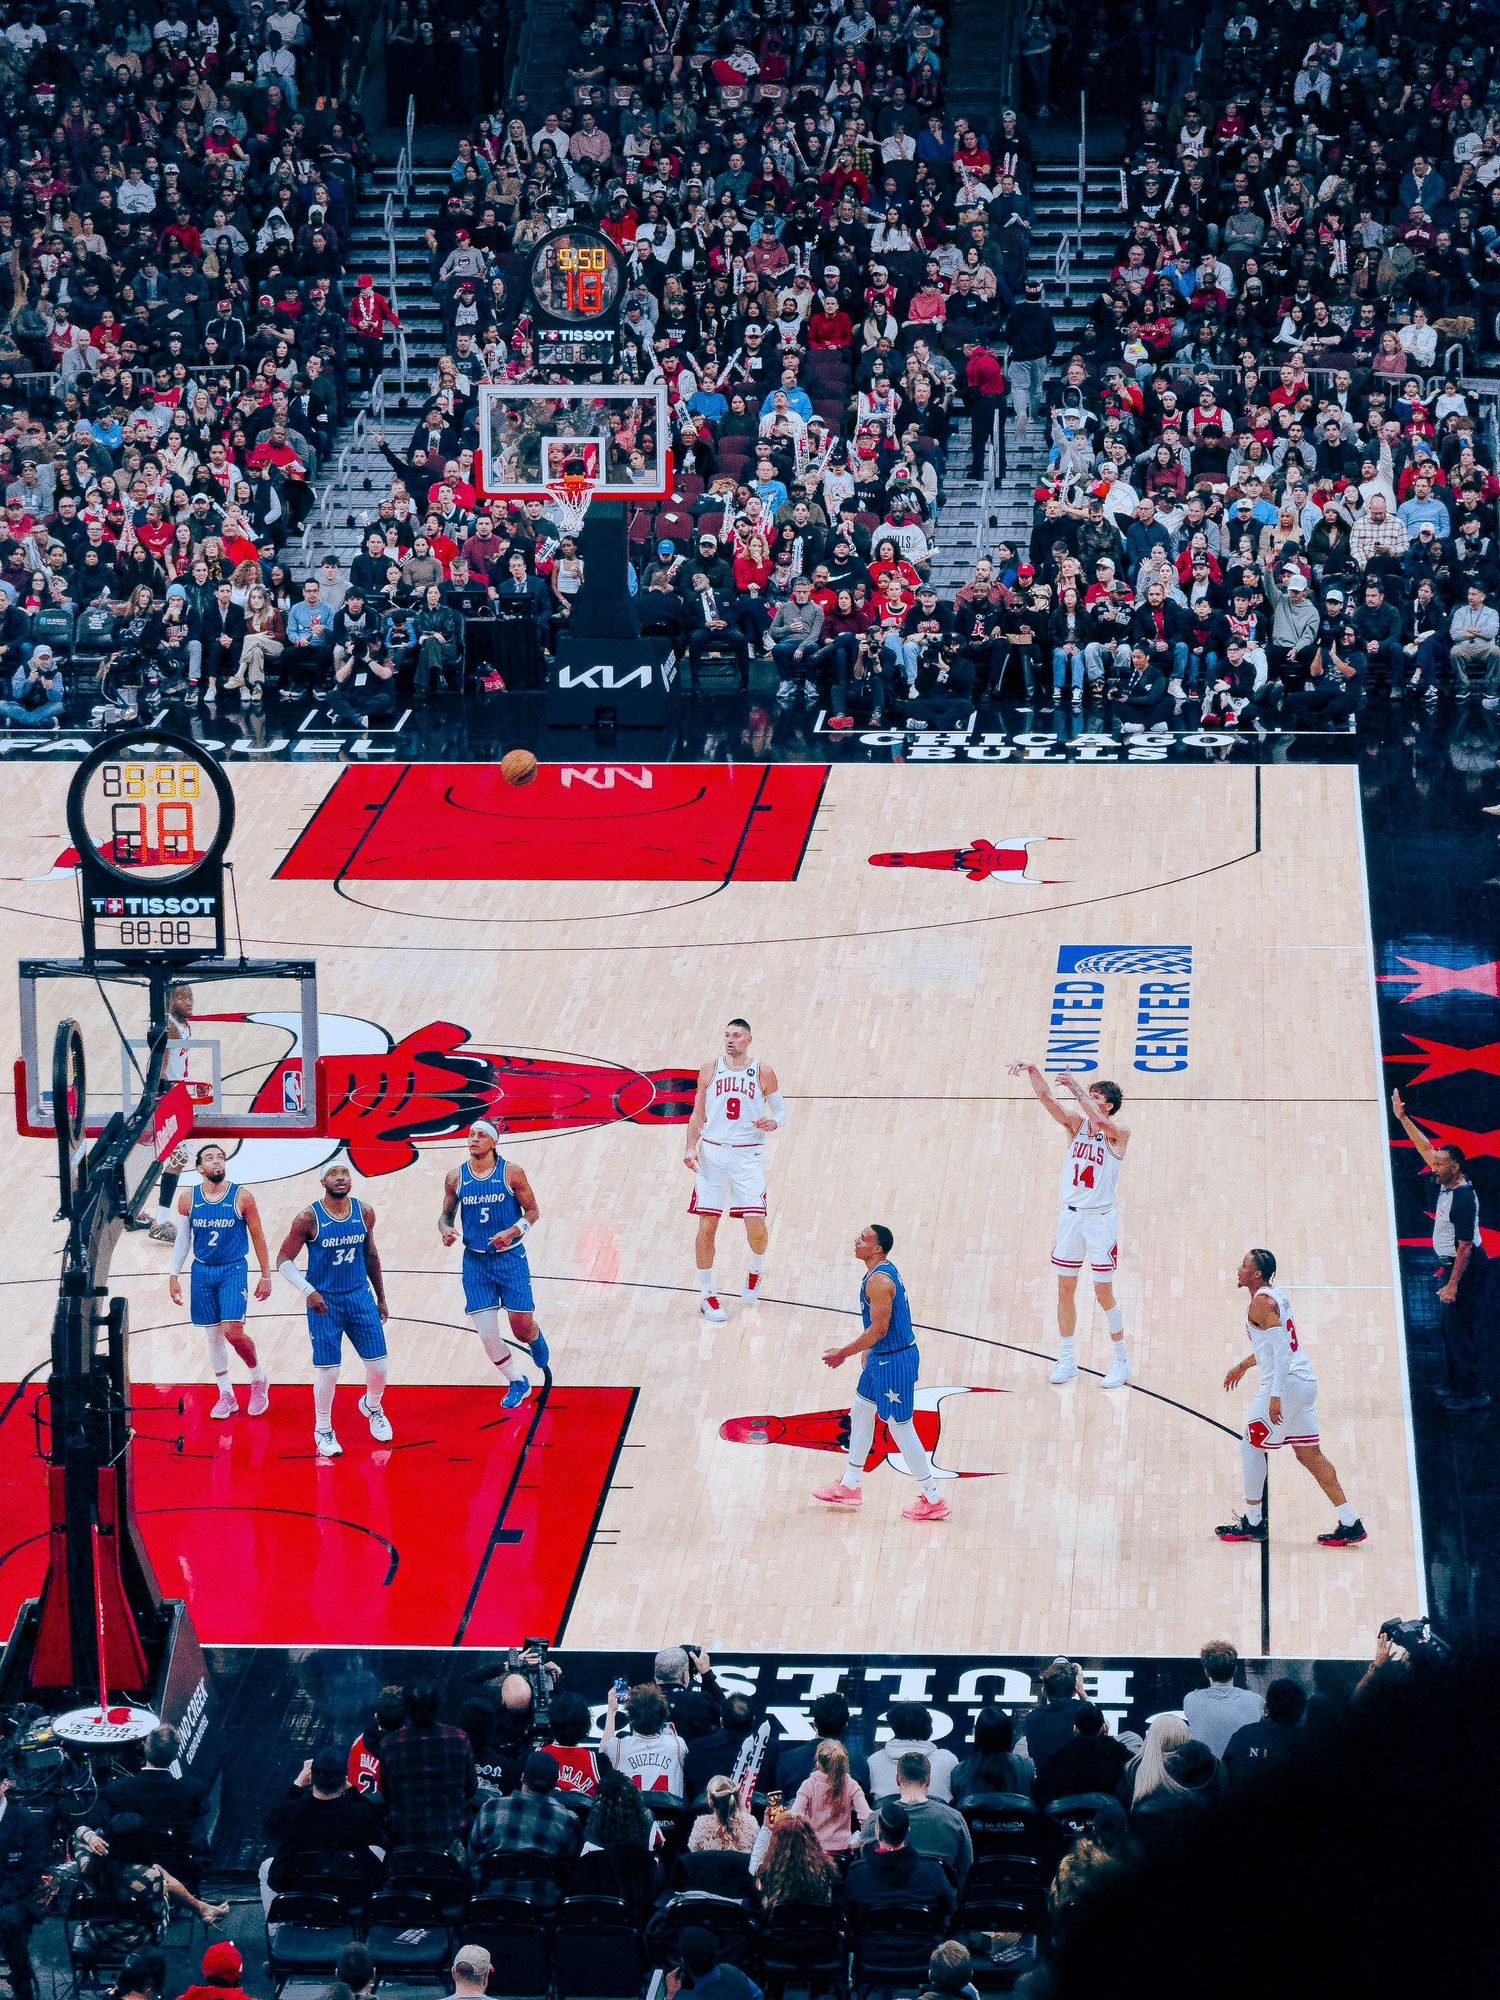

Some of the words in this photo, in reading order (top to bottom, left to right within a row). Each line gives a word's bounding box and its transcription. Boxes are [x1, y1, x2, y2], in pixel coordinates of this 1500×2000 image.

[559, 248, 606, 270] 5:50
[566, 271, 602, 312] 18
[559, 330, 615, 341] TISSOT
[559, 665, 652, 688] KIA
[859, 733, 1235, 746] CHICAGO
[907, 746, 1168, 760] BULLS
[124, 764, 201, 798] 5:50
[125, 898, 216, 914] TISSOT
[1044, 981, 1105, 1073] UNITED
[1133, 982, 1191, 1073] CENTER
[716, 1076, 756, 1099] BULLS
[726, 1097, 741, 1120] 9
[1072, 1164, 1095, 1189] 14
[479, 1207, 490, 1223] 5
[207, 1231, 219, 1247] 2
[332, 1248, 357, 1266] 34
[177, 1716, 191, 1758] IND
[187, 1677, 208, 1727] CREEK
[628, 1753, 672, 1770] BUZELIS
[559, 1766, 593, 1792] MAN
